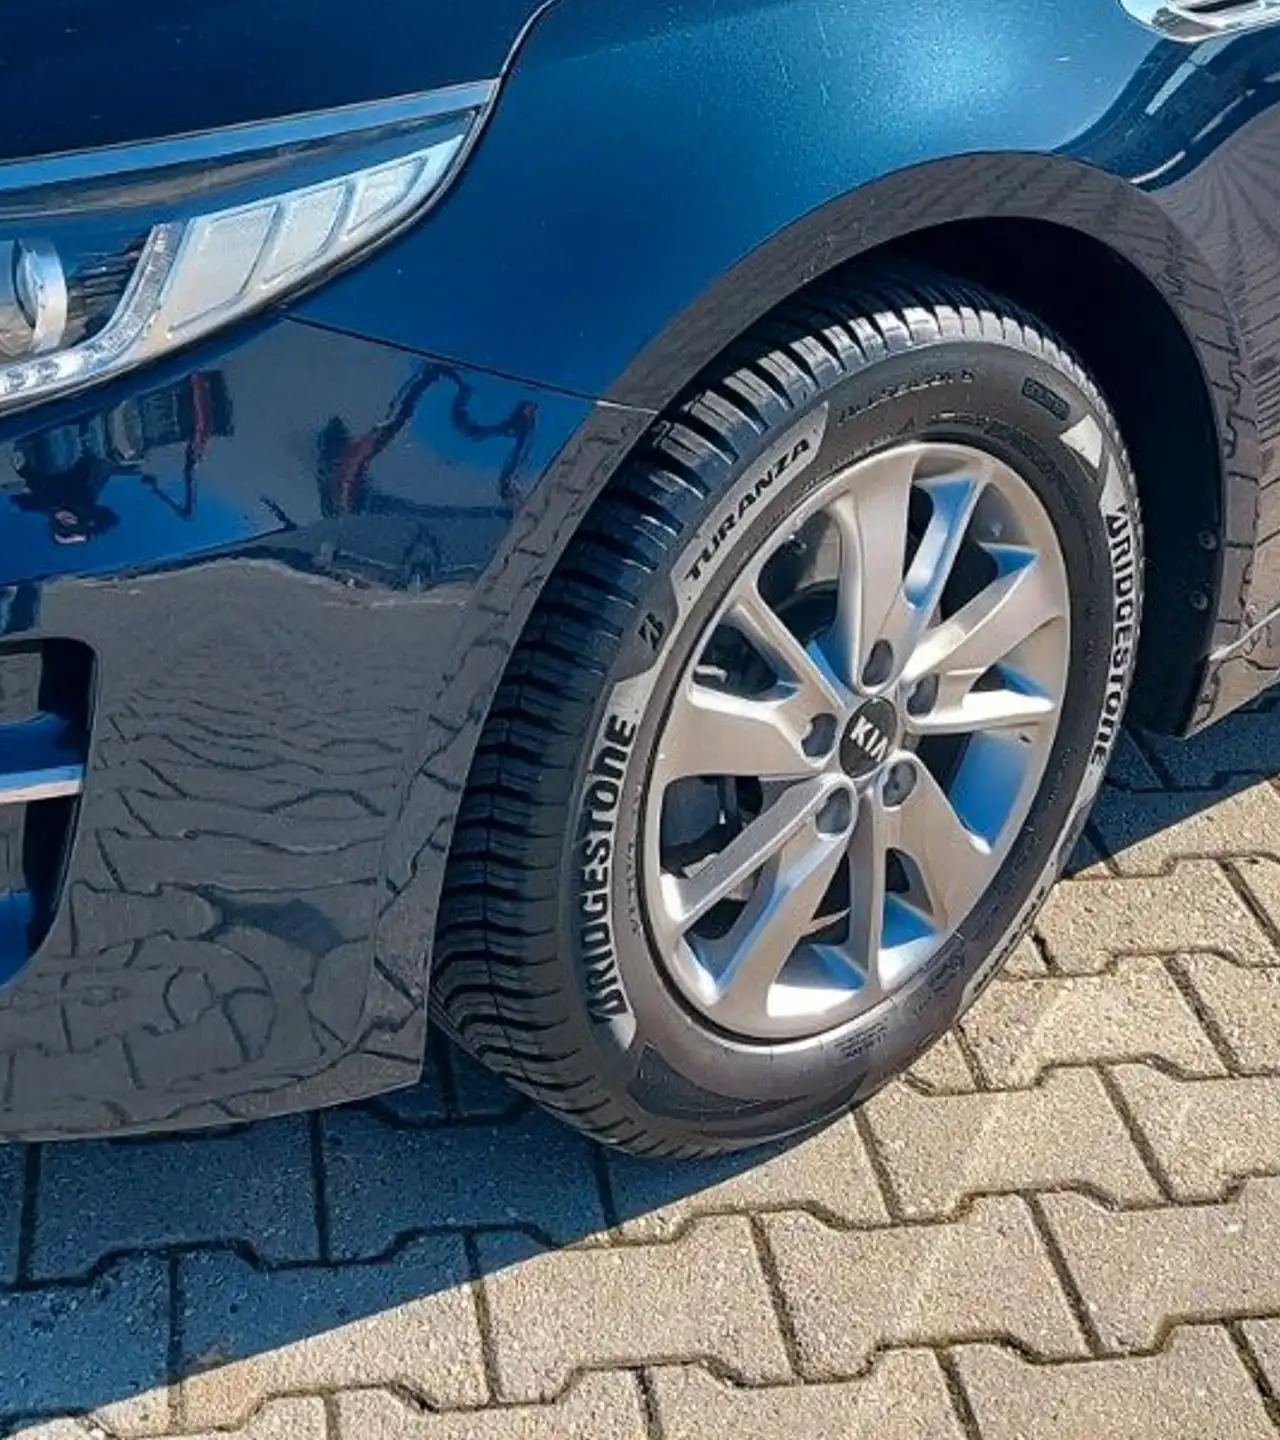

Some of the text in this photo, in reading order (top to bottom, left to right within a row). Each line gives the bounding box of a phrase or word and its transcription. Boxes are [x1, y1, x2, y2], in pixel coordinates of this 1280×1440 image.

[683, 438, 810, 582] TURANZA
[850, 715, 890, 764] KIA
[579, 712, 637, 1025] BRIDGESTONE
